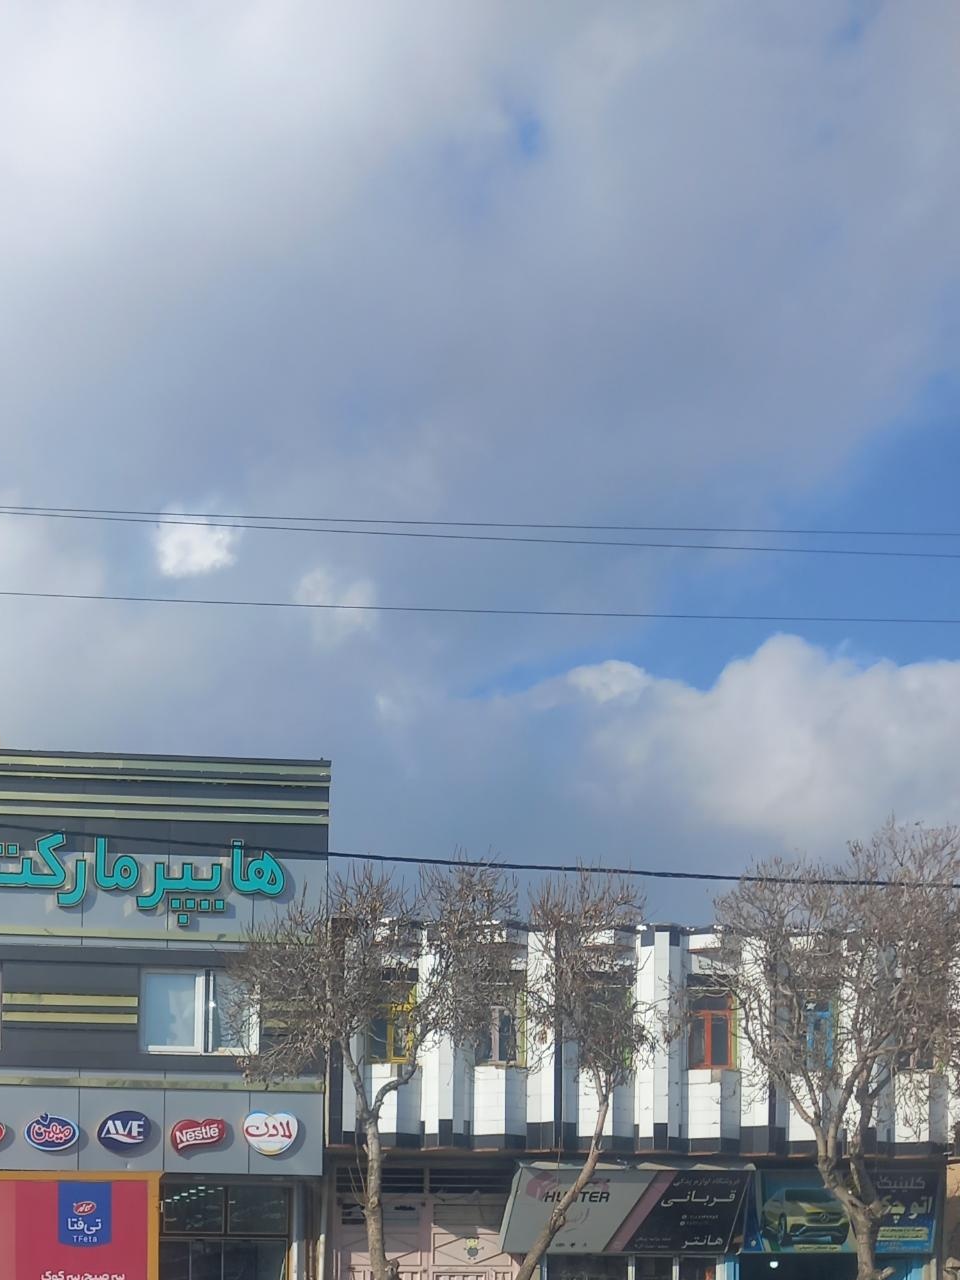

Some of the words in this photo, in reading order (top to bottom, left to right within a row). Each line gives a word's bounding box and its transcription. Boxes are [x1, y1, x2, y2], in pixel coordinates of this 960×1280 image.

[30, 1122, 73, 1144] میهن
[245, 1119, 293, 1140] لادن
[544, 1191, 610, 1203] HUTER
[661, 1190, 737, 1207] قربانی
[681, 1234, 724, 1249] هانتر
